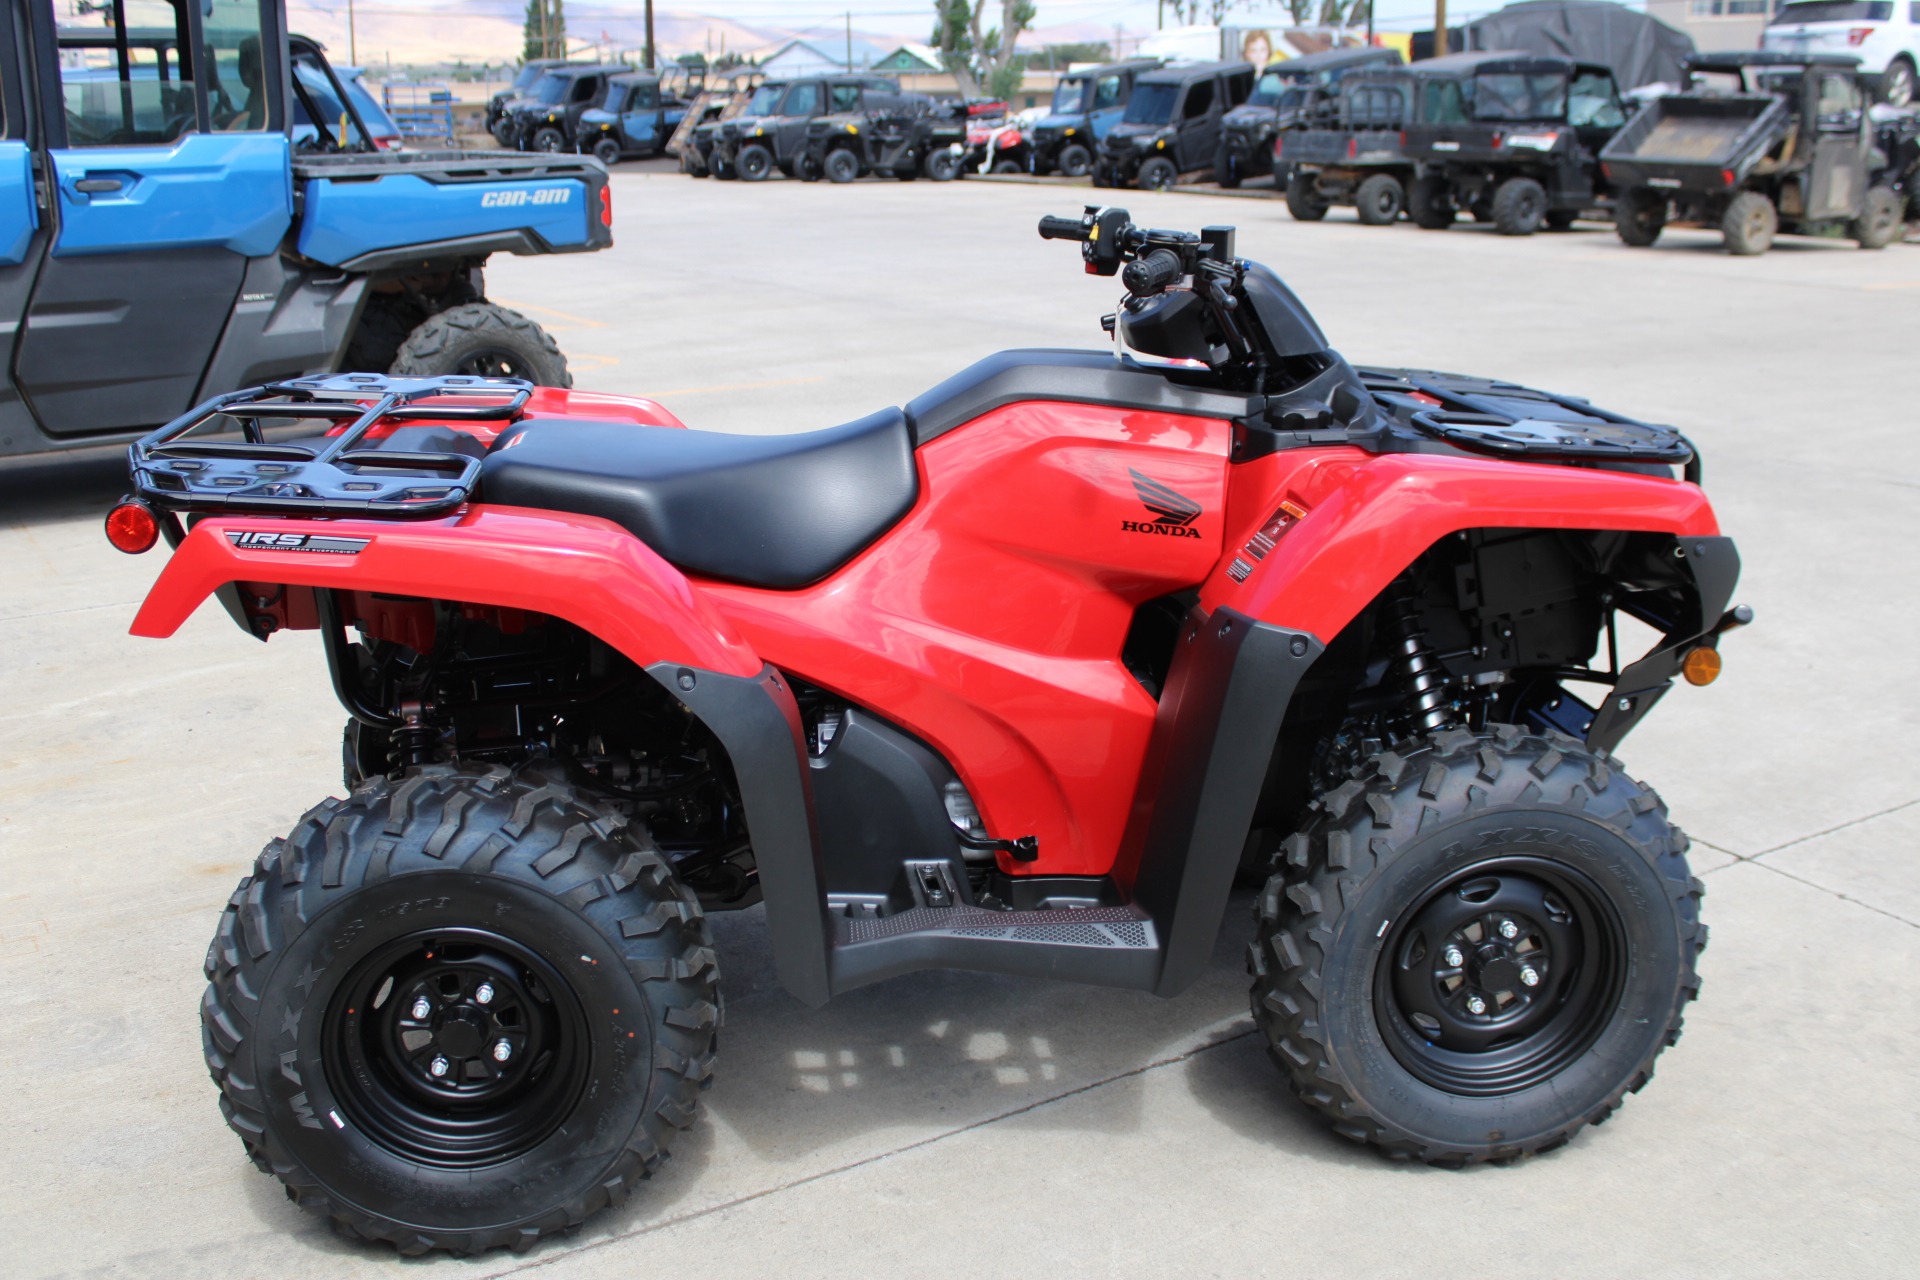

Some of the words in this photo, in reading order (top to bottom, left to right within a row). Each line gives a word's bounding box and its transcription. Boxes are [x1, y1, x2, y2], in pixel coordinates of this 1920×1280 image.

[481, 187, 571, 208] can-am
[240, 532, 306, 546] IRS
[1121, 520, 1202, 539] HONDA
